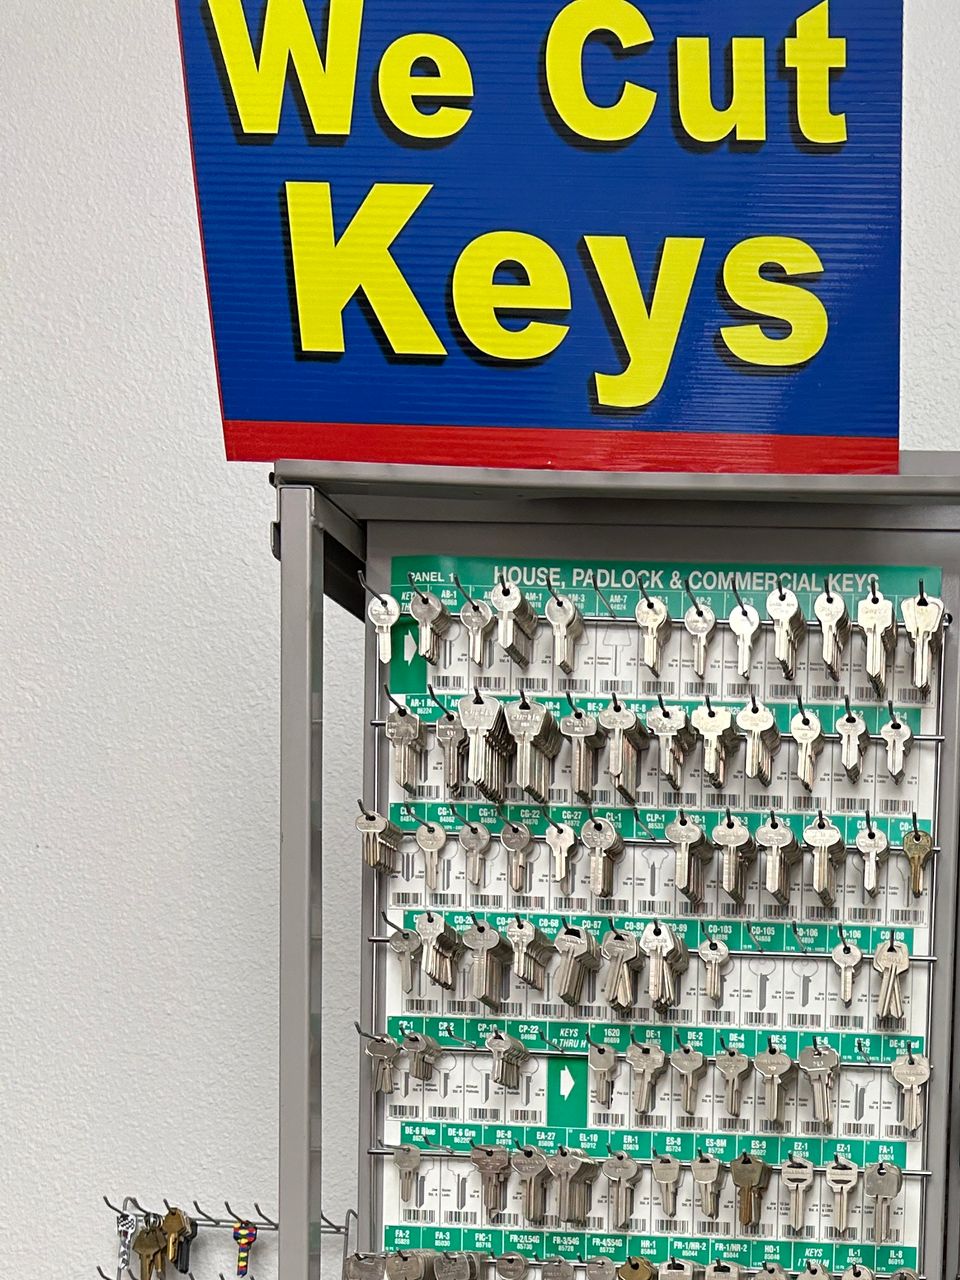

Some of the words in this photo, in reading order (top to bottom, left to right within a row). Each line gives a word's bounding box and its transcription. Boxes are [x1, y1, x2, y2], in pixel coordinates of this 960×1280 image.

[209, 0, 475, 139] We
[545, 0, 848, 144] Cut
[284, 181, 829, 408] Keys
[410, 572, 445, 582] PANEL
[448, 574, 454, 582] 1
[494, 567, 565, 589] HOUSE,
[572, 568, 664, 588] PADLOCK
[670, 571, 682, 588] &
[689, 572, 827, 591] COMMERCIAL
[828, 574, 880, 591] KEYS
[520, 810, 540, 818] CG-22
[562, 811, 582, 819] CG-27
[646, 814, 665, 822] CLP-1
[708, 925, 732, 934] CO-103
[751, 926, 775, 935] CO-105
[560, 1028, 578, 1037] KEYS
[604, 1028, 620, 1036] 1620
[646, 1030, 661, 1038] DE-1
[729, 1033, 744, 1041] DE-4
[560, 1038, 580, 1048] THRU
[580, 1040, 587, 1048] H
[537, 1132, 555, 1140] EA-27
[879, 1146, 893, 1154] FA-1
[395, 1230, 409, 1238] FA-2
[641, 1240, 656, 1248] HR-1
[805, 1248, 823, 1256] KEYS
